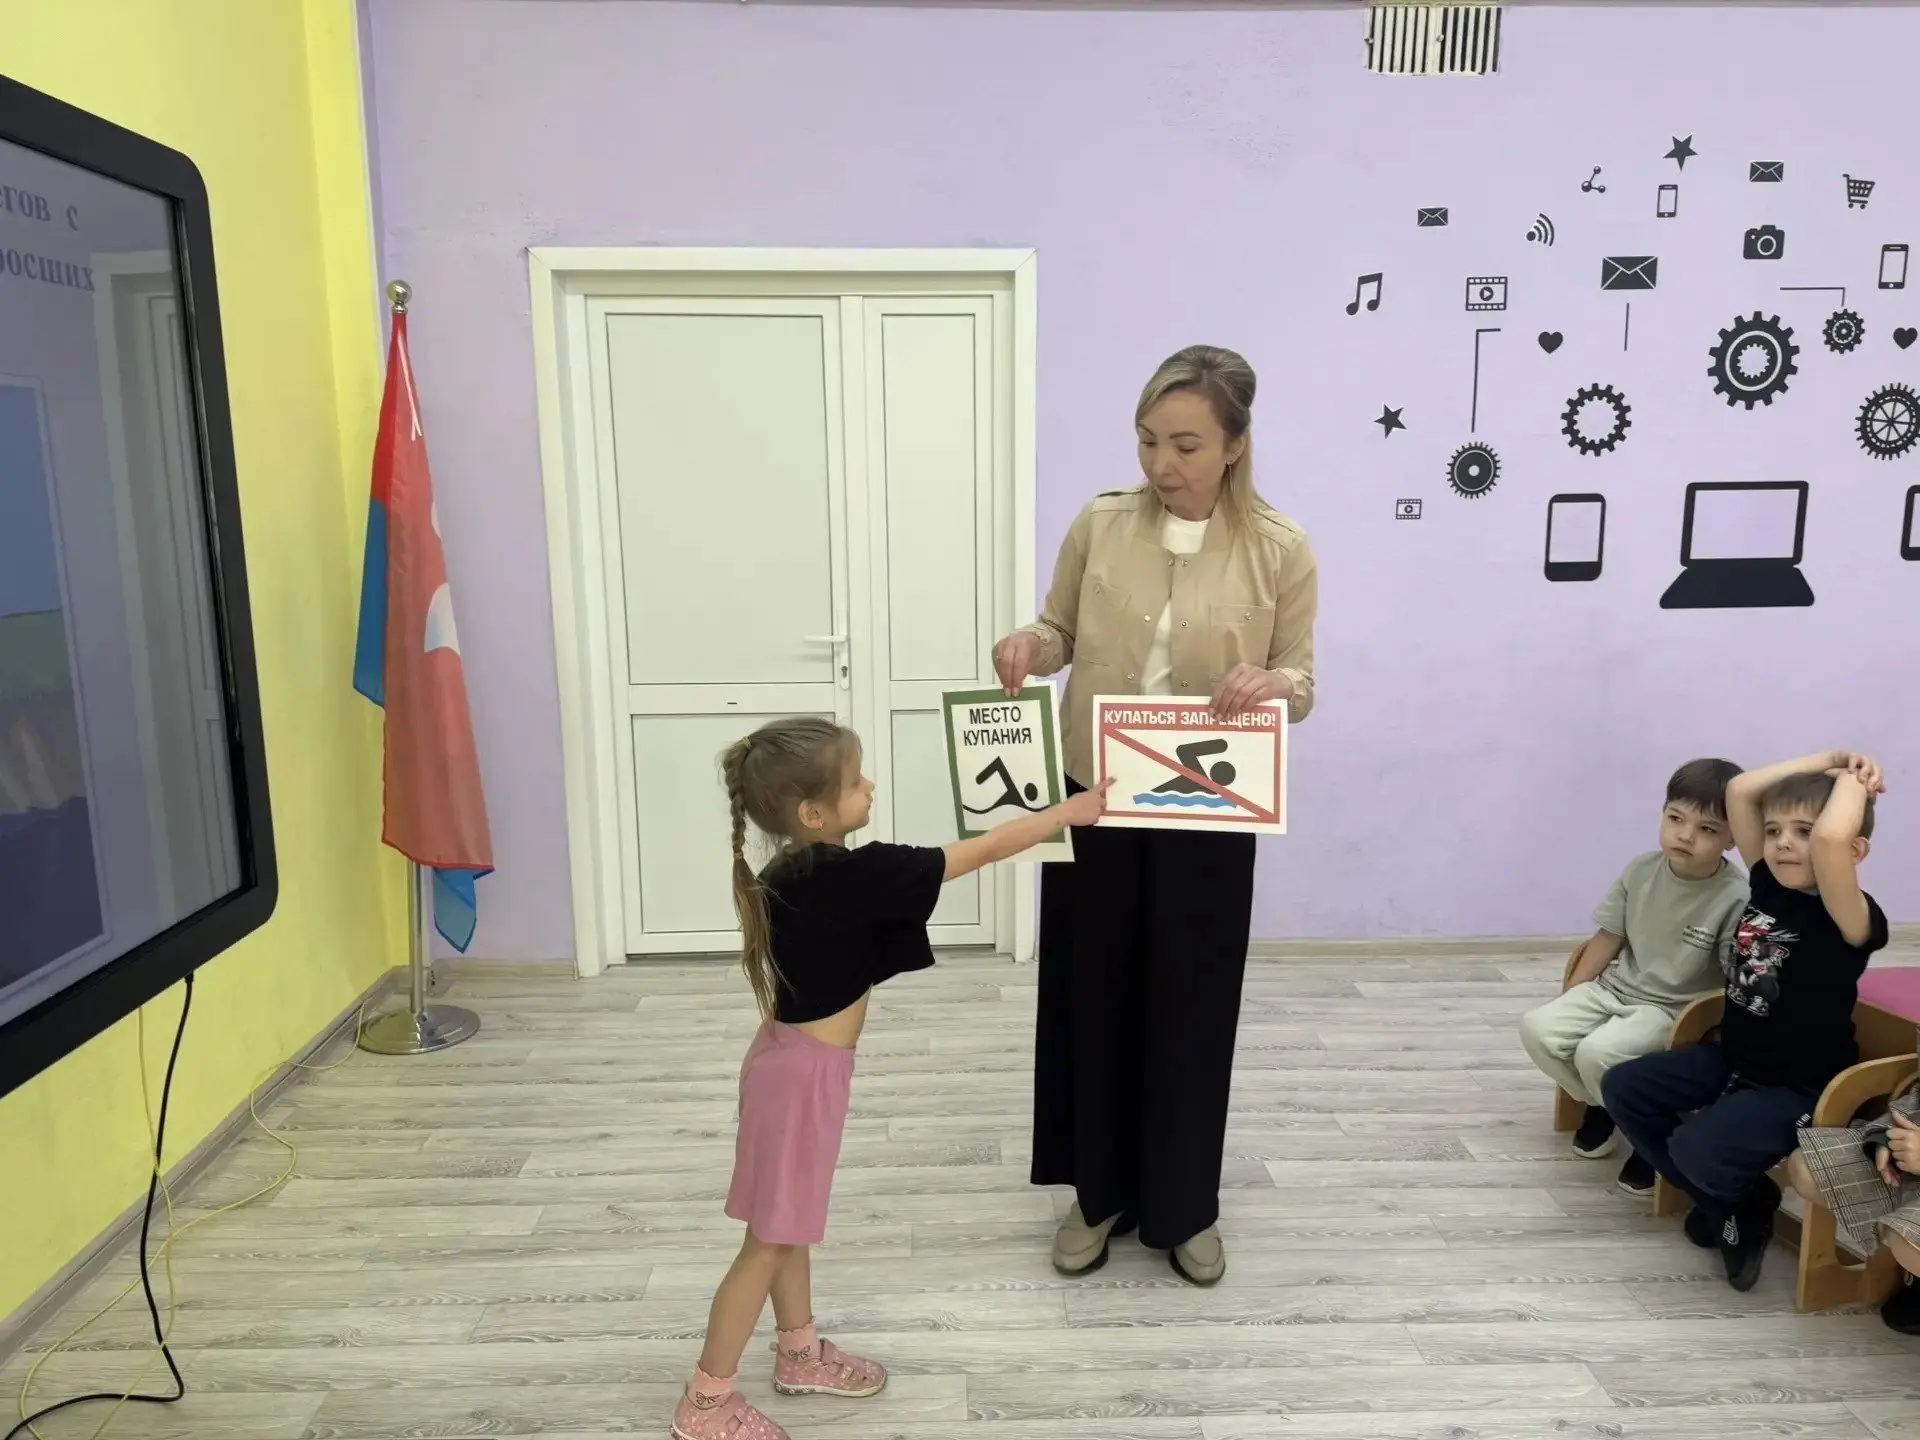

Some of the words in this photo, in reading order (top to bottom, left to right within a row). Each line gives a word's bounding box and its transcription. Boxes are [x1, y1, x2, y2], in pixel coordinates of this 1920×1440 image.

[0, 183, 51, 222] гов
[969, 706, 1022, 724] МЕСТО
[1104, 709, 1176, 725] КУПАТЬСЯ
[1180, 711, 1276, 728] ЗАПЩЕНО!
[963, 727, 1033, 746] КУПАНИЯ
